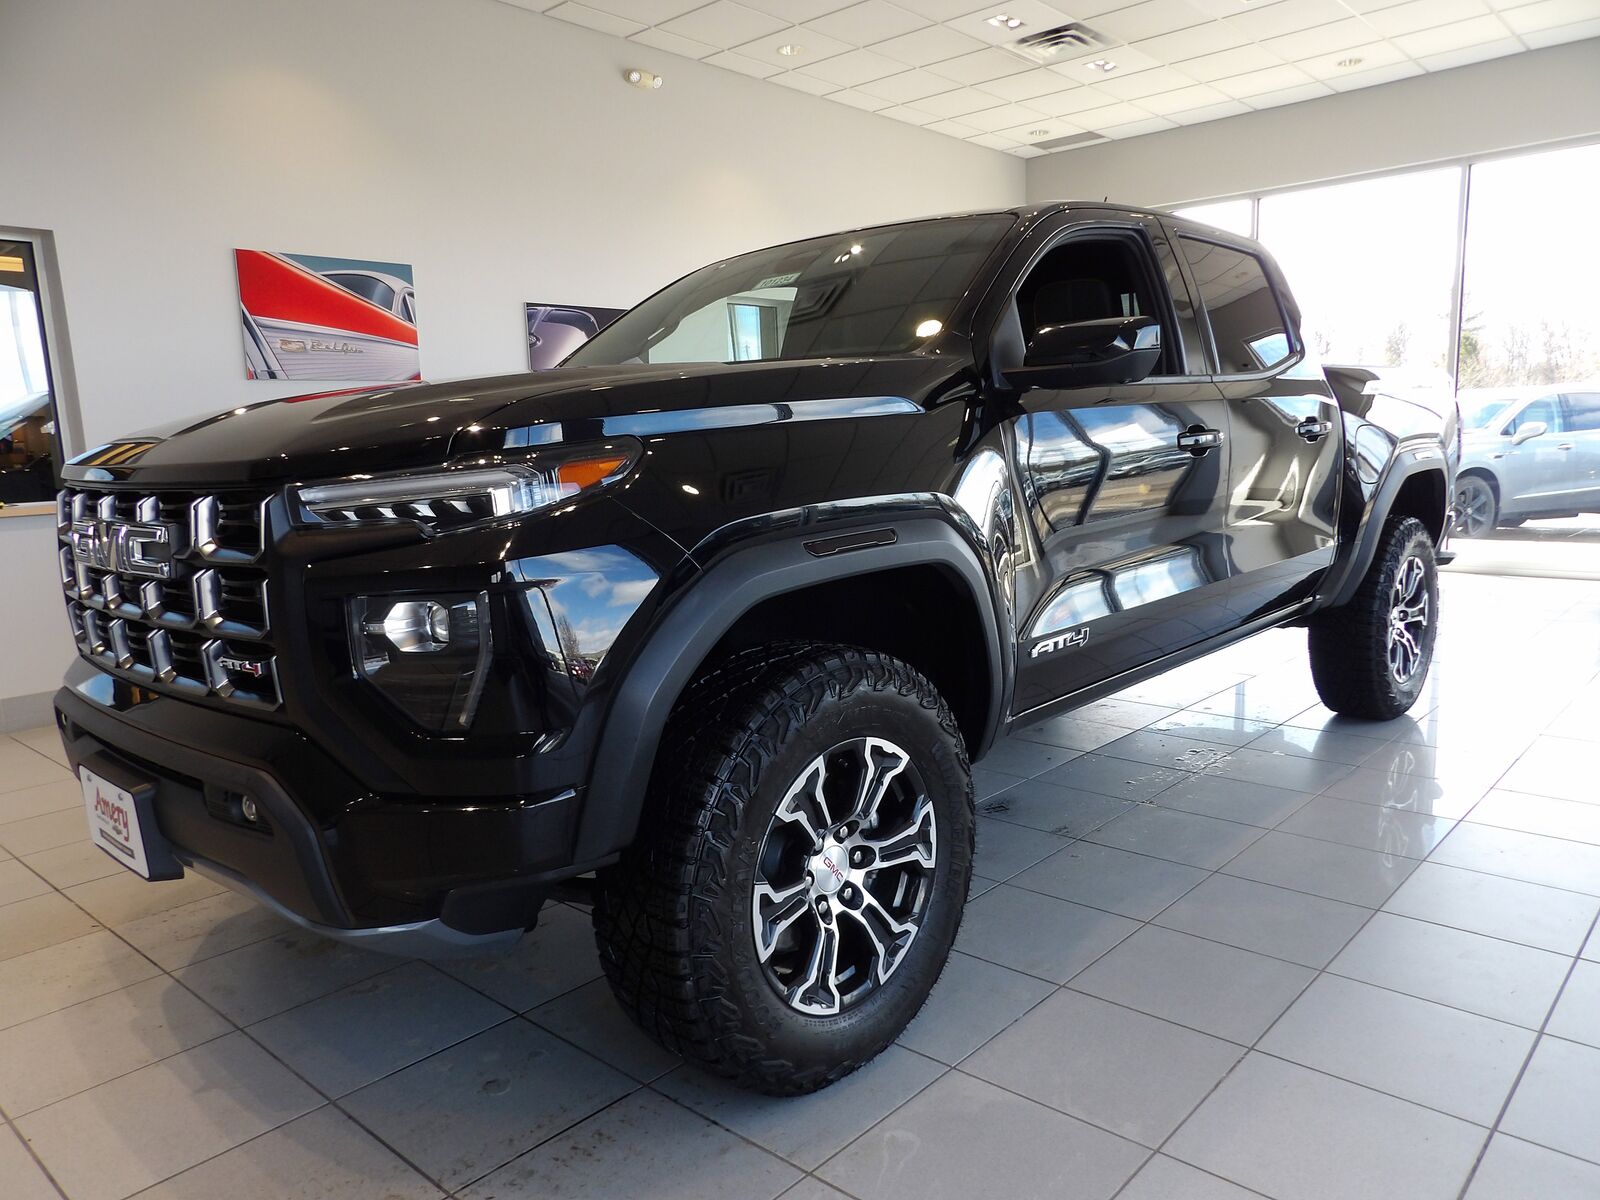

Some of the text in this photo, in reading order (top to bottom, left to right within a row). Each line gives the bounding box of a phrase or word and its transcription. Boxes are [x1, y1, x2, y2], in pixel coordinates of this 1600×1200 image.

[72, 520, 169, 578] GMC
[1030, 627, 1090, 658] AT4
[217, 656, 262, 677] AT4
[95, 785, 129, 842] Amery
[823, 856, 844, 882] GMC
